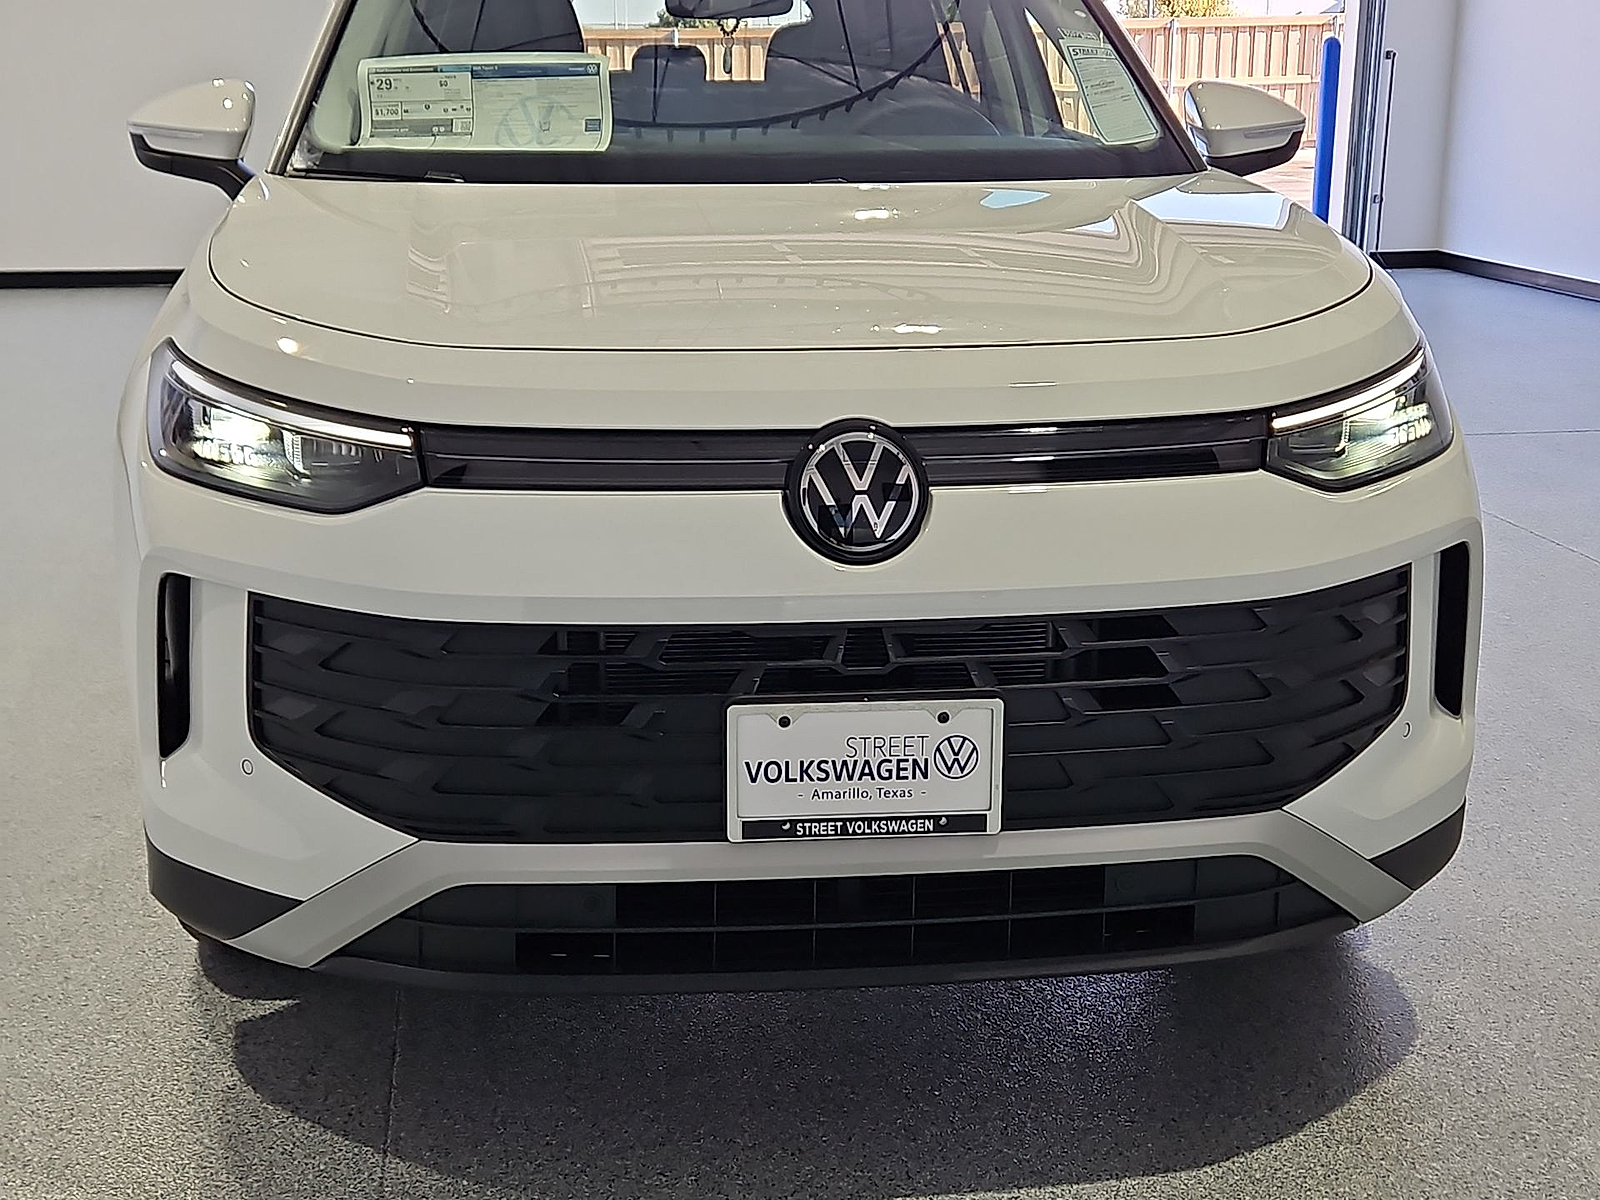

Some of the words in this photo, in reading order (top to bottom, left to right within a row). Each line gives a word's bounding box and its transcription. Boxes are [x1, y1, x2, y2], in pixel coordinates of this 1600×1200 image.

[376, 78, 393, 91] 29
[375, 108, 399, 117] $1,700
[845, 735, 930, 758] STREET
[743, 757, 930, 784] VOLKSWAGEN
[811, 788, 873, 801] Amarillo,
[876, 787, 914, 799] Texas
[796, 821, 843, 836] STREET
[846, 819, 934, 835] VOLKSWAGEN
